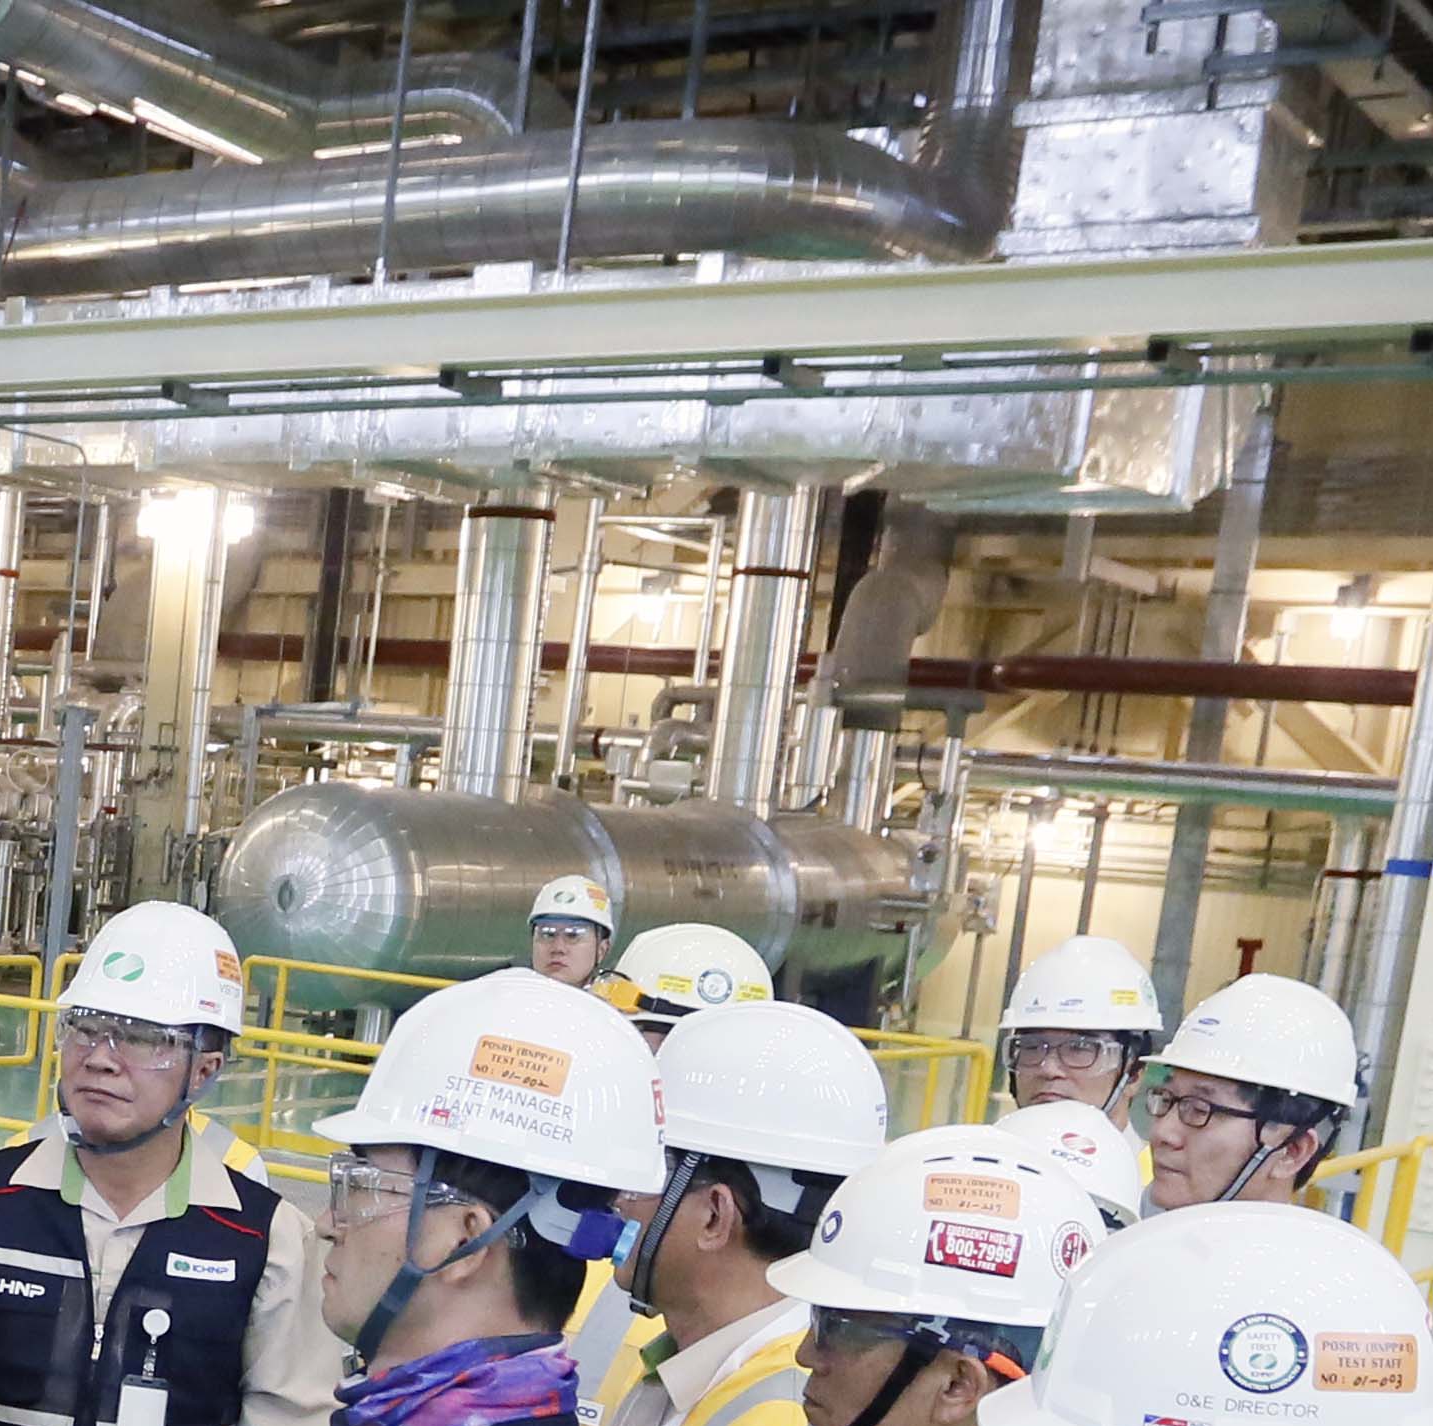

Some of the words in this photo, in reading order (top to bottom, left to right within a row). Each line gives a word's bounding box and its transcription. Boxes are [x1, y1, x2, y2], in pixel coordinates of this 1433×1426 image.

[491, 1053, 515, 1066] TEST
[518, 1059, 549, 1075] STAFF
[445, 1075, 487, 1097] SITE
[488, 1085, 574, 1120] MANAGER
[433, 1095, 485, 1117] PLANT
[489, 1106, 575, 1144] MANAGER
[942, 1186, 968, 1196] TEST
[945, 1224, 989, 1241] EMERGENCY
[945, 1235, 1014, 1265] 800-7999
[191, 1264, 229, 1274] KHNP
[957, 1256, 977, 1268] TOLL
[977, 1260, 997, 1271] FREE
[1246, 1332, 1282, 1342] SAFETY
[1250, 1343, 1277, 1352] FIRST
[1337, 1357, 1366, 1369] TEST
[1371, 1358, 1402, 1370] STAFF
[1175, 1392, 1214, 1410] O&E
[1224, 1398, 1320, 1419] DIRECTOR
